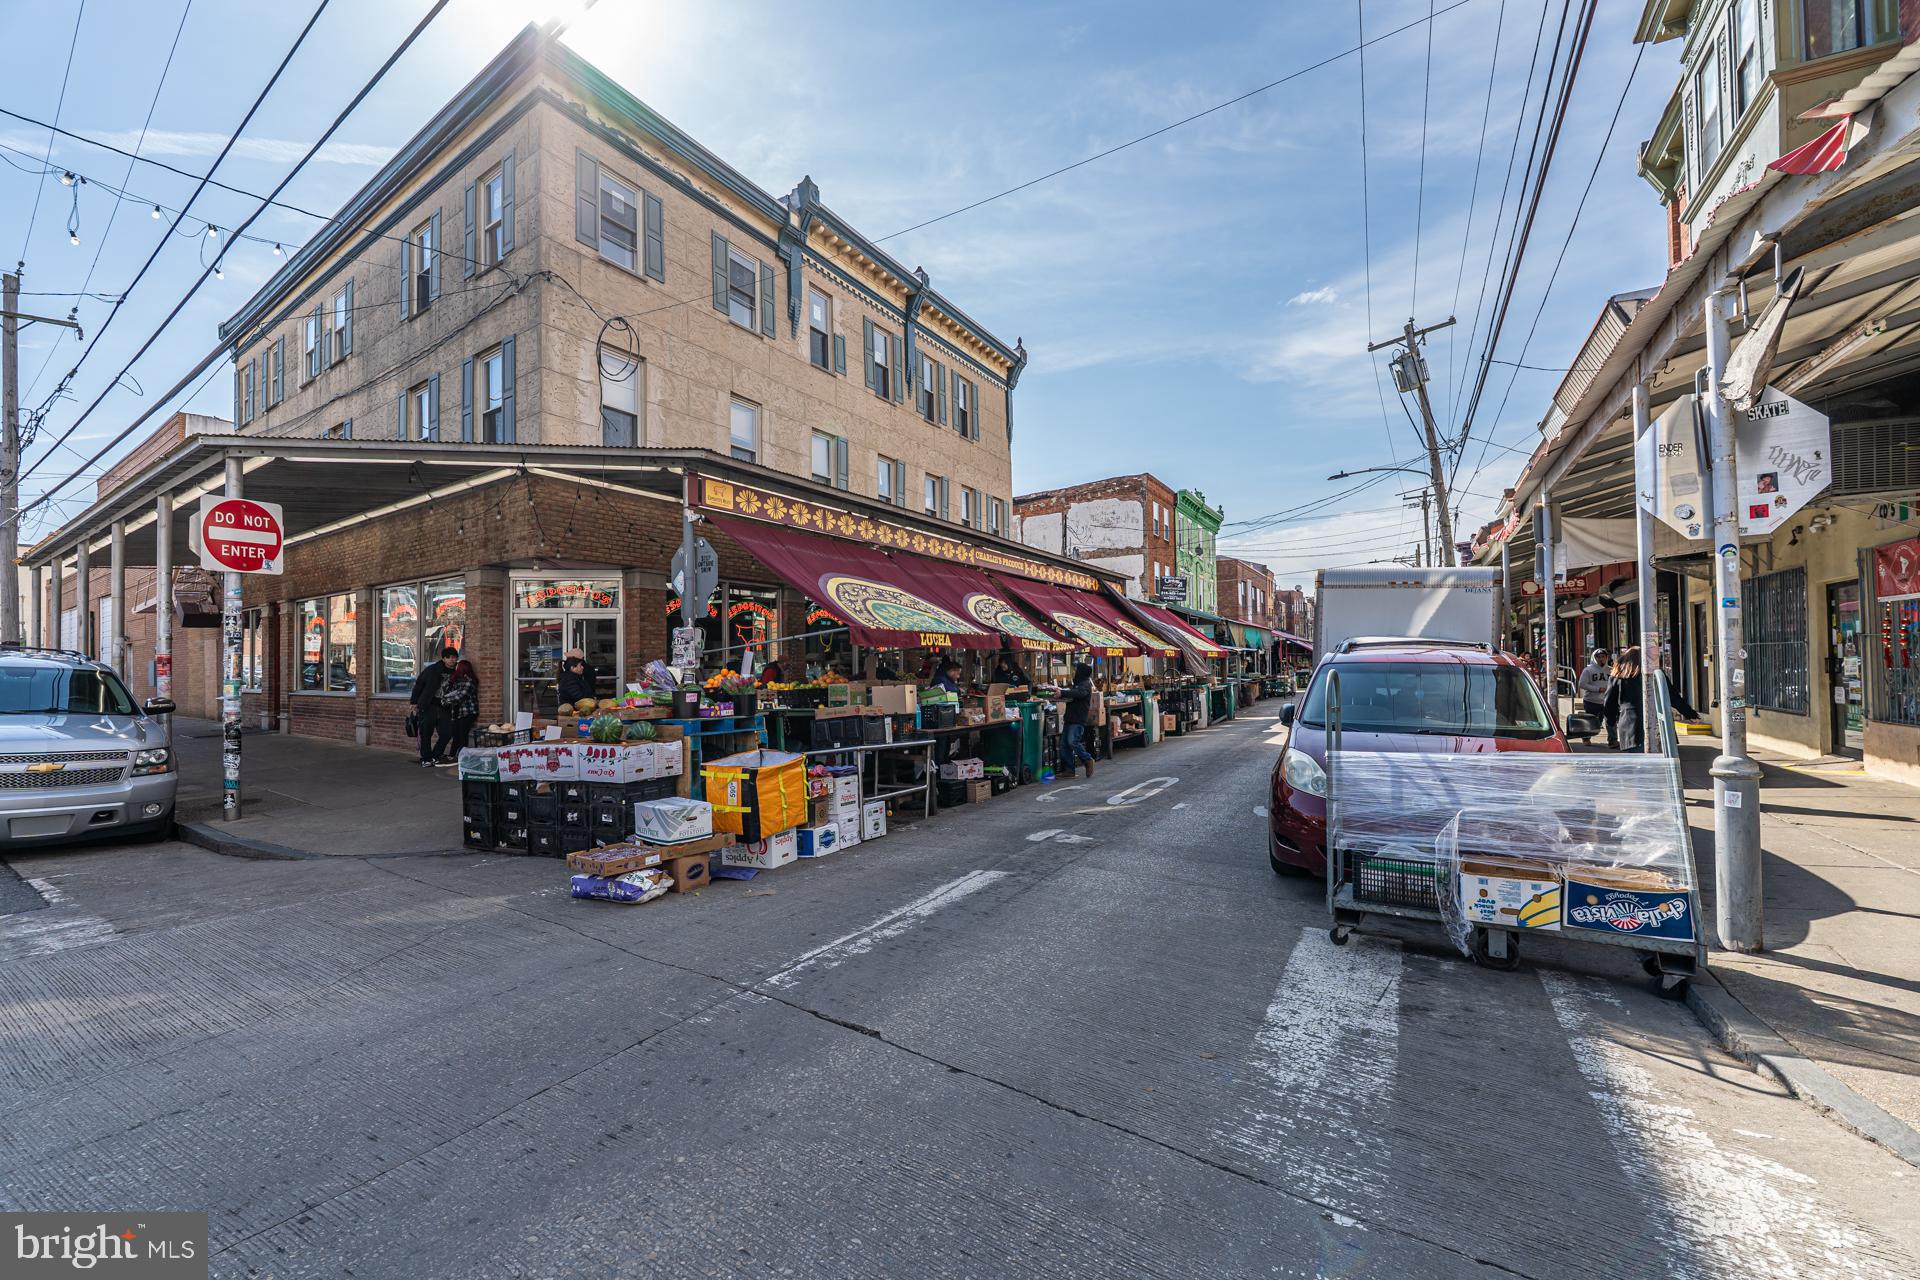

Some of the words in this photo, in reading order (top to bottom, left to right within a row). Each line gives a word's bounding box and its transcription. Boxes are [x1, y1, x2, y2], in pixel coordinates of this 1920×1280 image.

[1748, 400, 1789, 421] SKATE!
[1658, 443, 1684, 453] ENDER
[215, 511, 235, 524] DO
[244, 515, 271, 529] NOT
[221, 544, 266, 559] ENTER
[920, 633, 952, 646] LUCHA
[725, 853, 754, 865] Apples
[1571, 906, 1617, 922] vista
